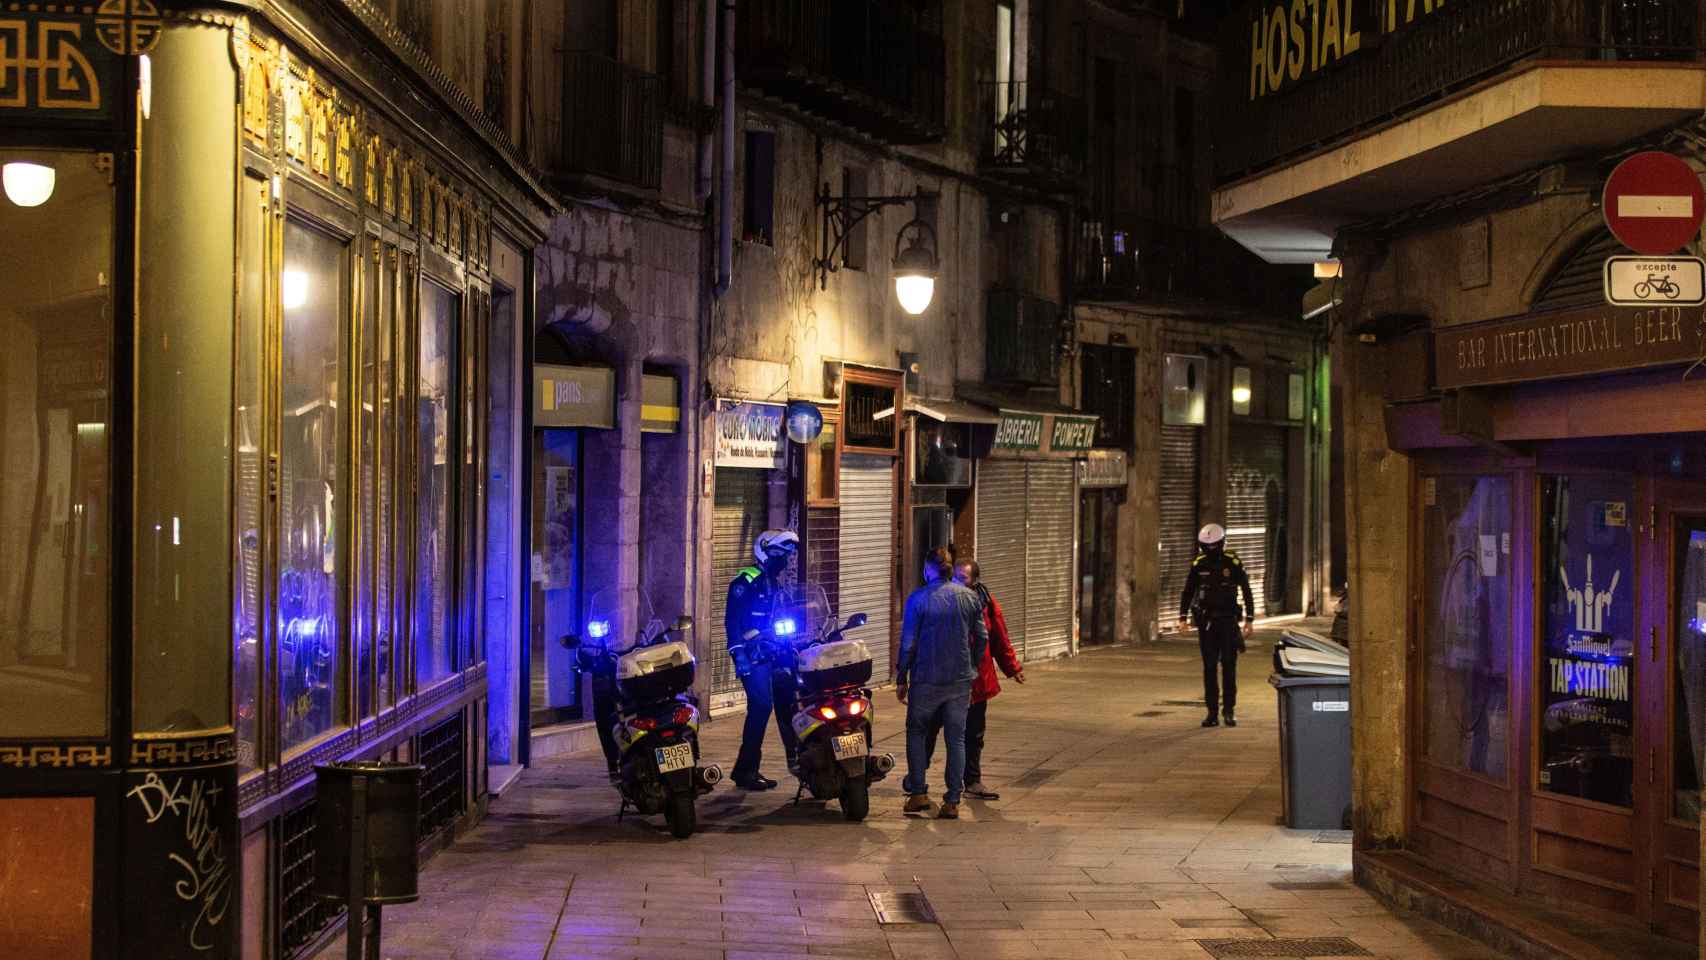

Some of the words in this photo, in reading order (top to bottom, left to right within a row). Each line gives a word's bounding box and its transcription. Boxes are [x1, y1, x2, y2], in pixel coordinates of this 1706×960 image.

[1250, 0, 1361, 100] HOSTAL
[1635, 262, 1678, 273] excepte
[1458, 336, 1487, 369] BAR
[1494, 315, 1622, 365] INTERNATIONAL
[1633, 305, 1682, 347] BEER
[995, 417, 1041, 446] LIBRERIA
[1550, 657, 1573, 694] TAP
[1575, 660, 1629, 702] STATION
[664, 745, 690, 759] 9059
[666, 757, 686, 769] HTV
